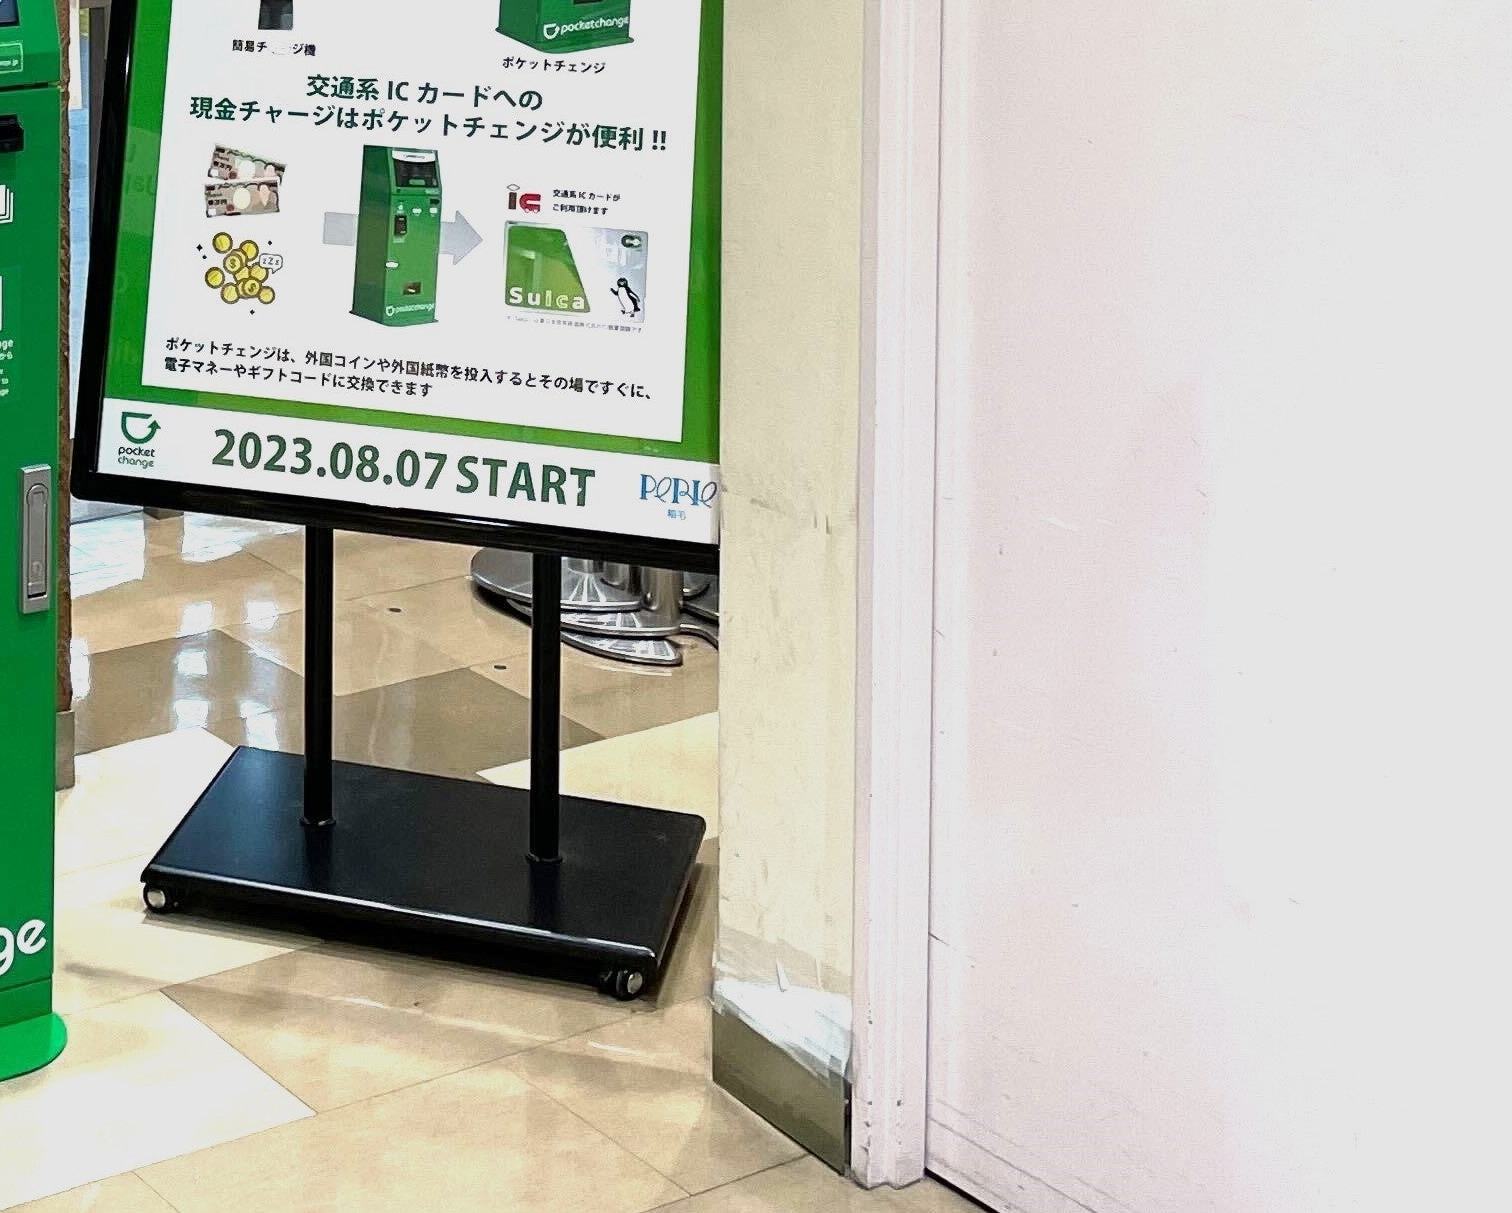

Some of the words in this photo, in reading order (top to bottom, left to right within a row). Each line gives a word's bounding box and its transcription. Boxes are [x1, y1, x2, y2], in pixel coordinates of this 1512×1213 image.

[231, 39, 316, 57] 簡易チジ機
[502, 56, 606, 74] ポケットチェンジ
[305, 72, 380, 102] 交通系
[386, 80, 409, 103] IC
[417, 81, 544, 113] カードへの
[188, 94, 645, 152] 現金チャージはポケットチェンジが便利
[163, 356, 434, 398] 電子マネーやギフトコードに交換できます
[117, 455, 155, 470] change
[118, 446, 156, 458] pocket
[211, 428, 448, 492] 2023.08.07
[455, 461, 597, 508] START
